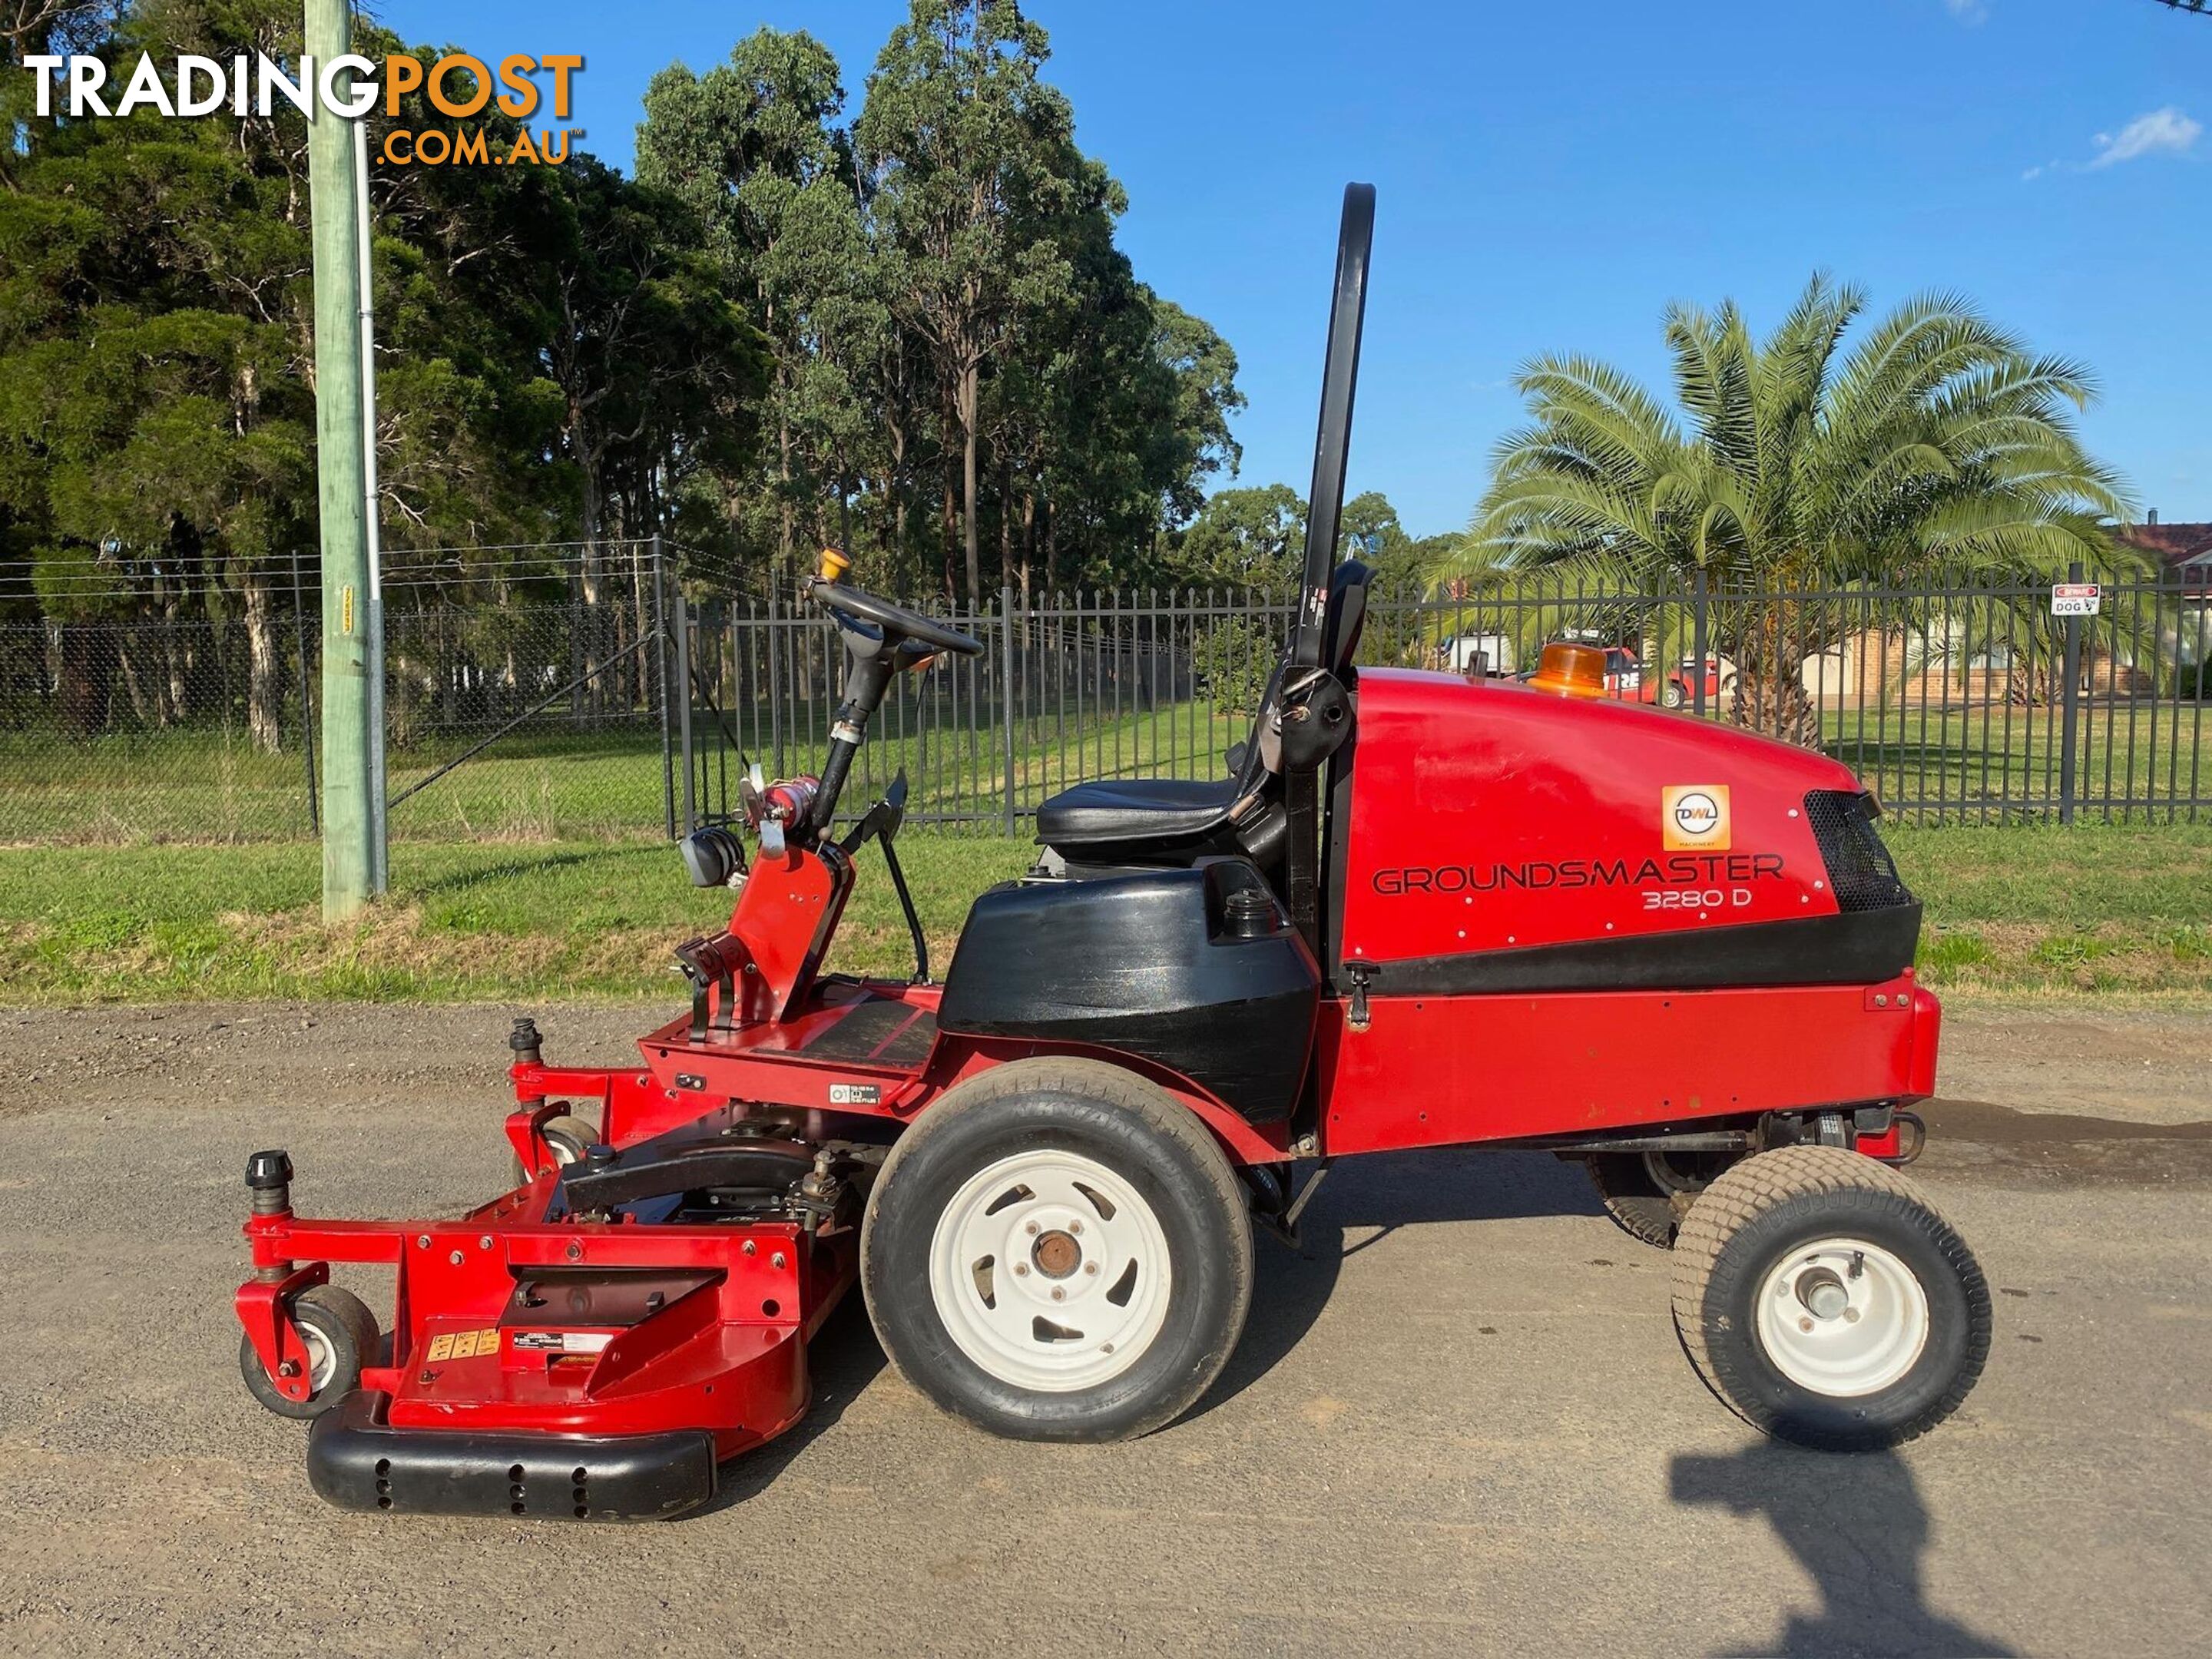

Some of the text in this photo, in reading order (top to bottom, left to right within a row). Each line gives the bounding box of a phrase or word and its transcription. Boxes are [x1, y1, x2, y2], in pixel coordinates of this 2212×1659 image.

[2056, 603, 2081, 611] DOG
[1373, 854, 1785, 894] GROUNDSMASTER
[1641, 889, 1752, 909] 3280 D
